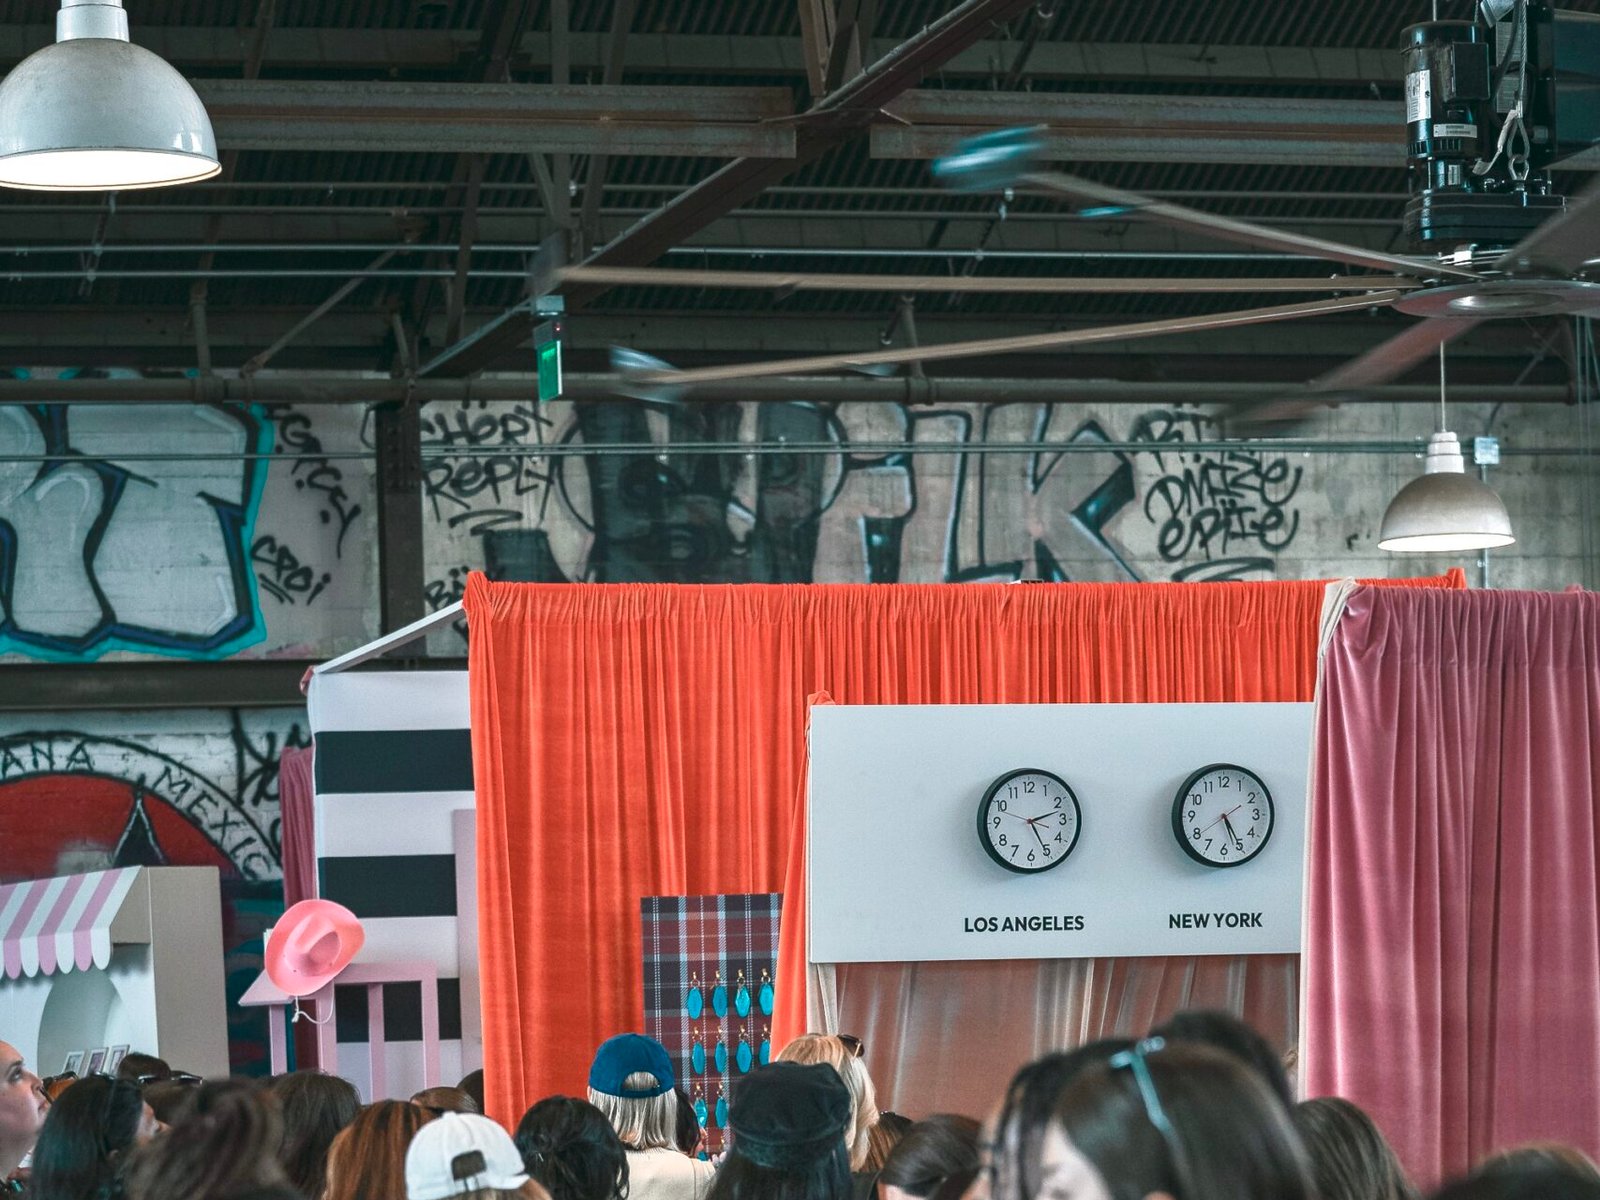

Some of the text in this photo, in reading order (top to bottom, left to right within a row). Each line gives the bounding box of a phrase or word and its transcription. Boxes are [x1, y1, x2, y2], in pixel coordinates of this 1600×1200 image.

[1022, 781, 1036, 794] 12
[1203, 781, 1213, 794] 11
[1217, 775, 1230, 789] 12
[1007, 786, 1019, 800] 11
[1190, 793, 1203, 806] 10
[1247, 791, 1256, 805] 2
[995, 799, 1008, 813] 10
[1053, 796, 1063, 809] 2
[1058, 812, 1068, 826] 3
[1187, 809, 1196, 823] 9
[1251, 807, 1261, 822] 3
[992, 816, 1002, 830] 9
[1053, 830, 1063, 844] 4
[1192, 827, 1202, 841] 8
[1246, 825, 1256, 839] 4
[998, 833, 1008, 847] 8
[1204, 838, 1214, 852] 7
[1235, 837, 1244, 852] 5
[1010, 844, 1020, 858] 7
[1026, 848, 1036, 862] 6
[1042, 843, 1051, 857] 5
[1219, 842, 1229, 856] 6
[965, 914, 1085, 933] LOS ANGELES
[1168, 911, 1264, 930] NEW YORK
